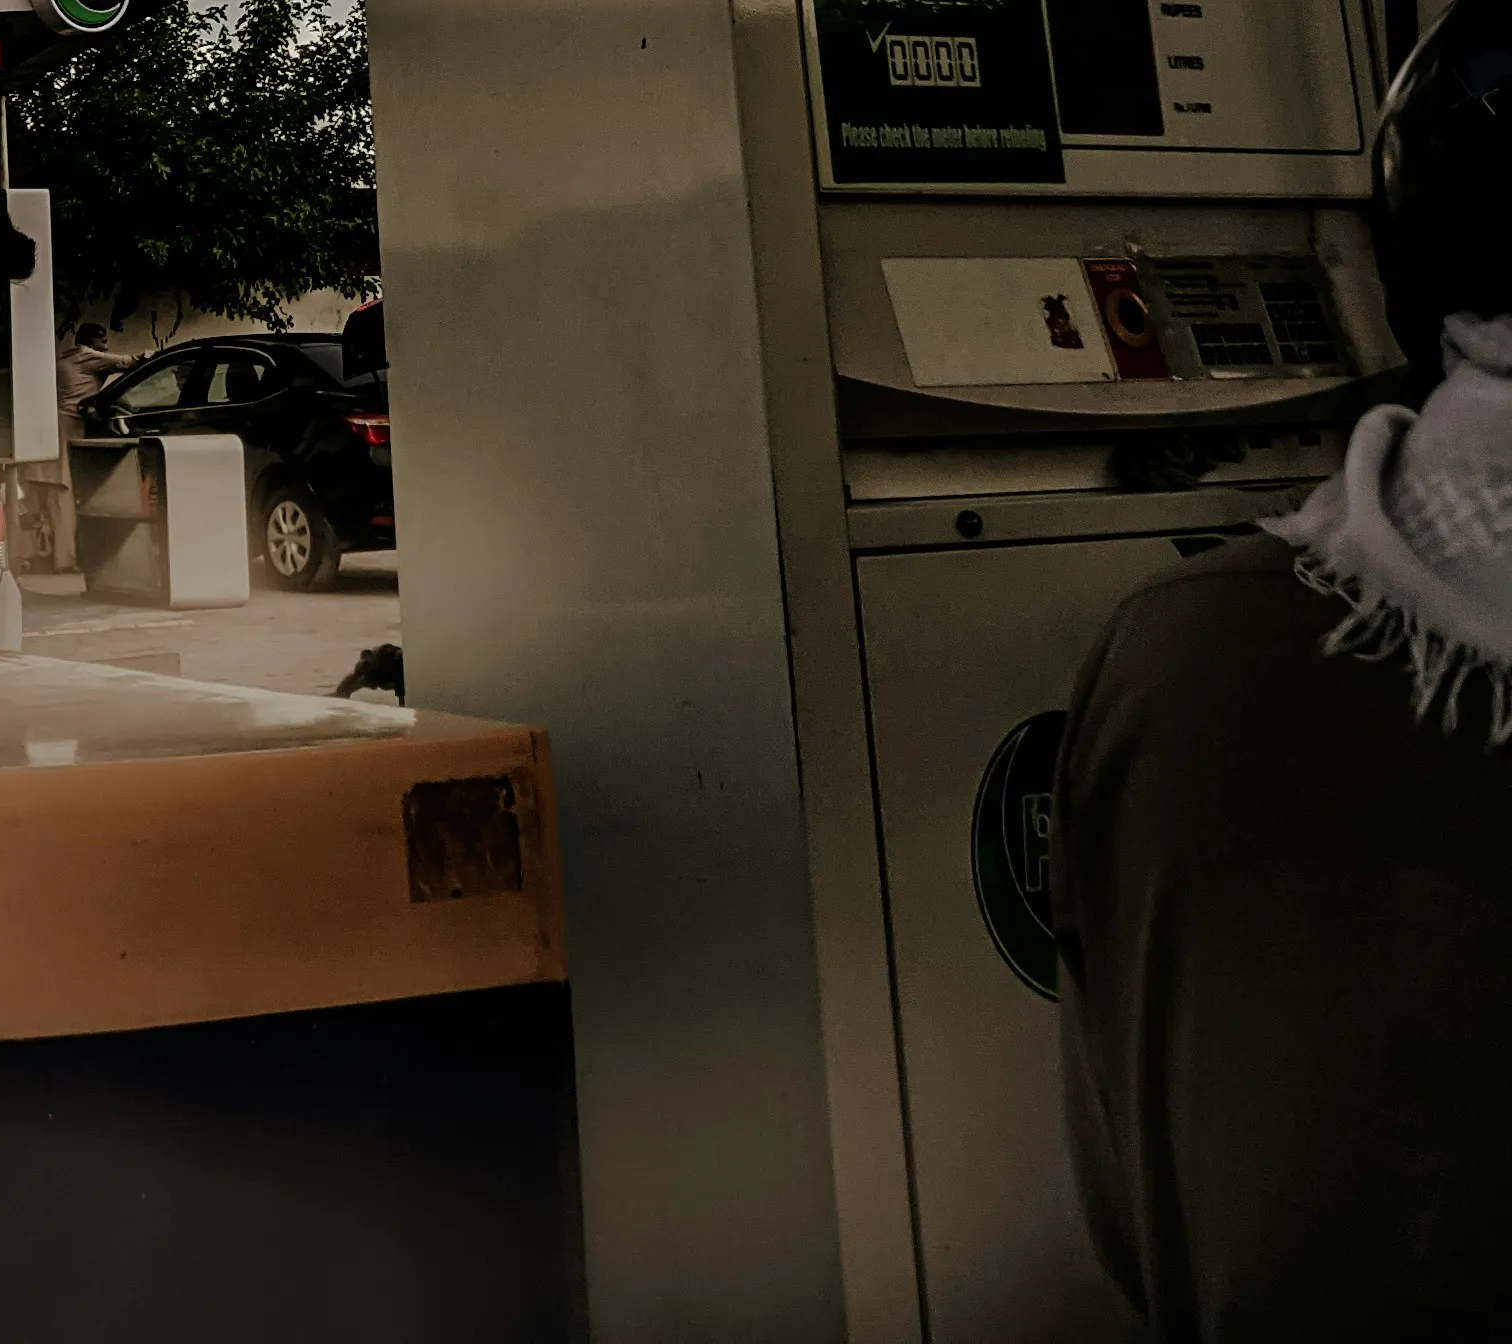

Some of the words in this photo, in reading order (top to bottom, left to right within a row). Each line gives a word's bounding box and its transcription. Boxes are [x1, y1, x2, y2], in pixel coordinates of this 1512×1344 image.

[840, 121, 878, 149] Please
[878, 121, 912, 149] check
[911, 123, 931, 149] the
